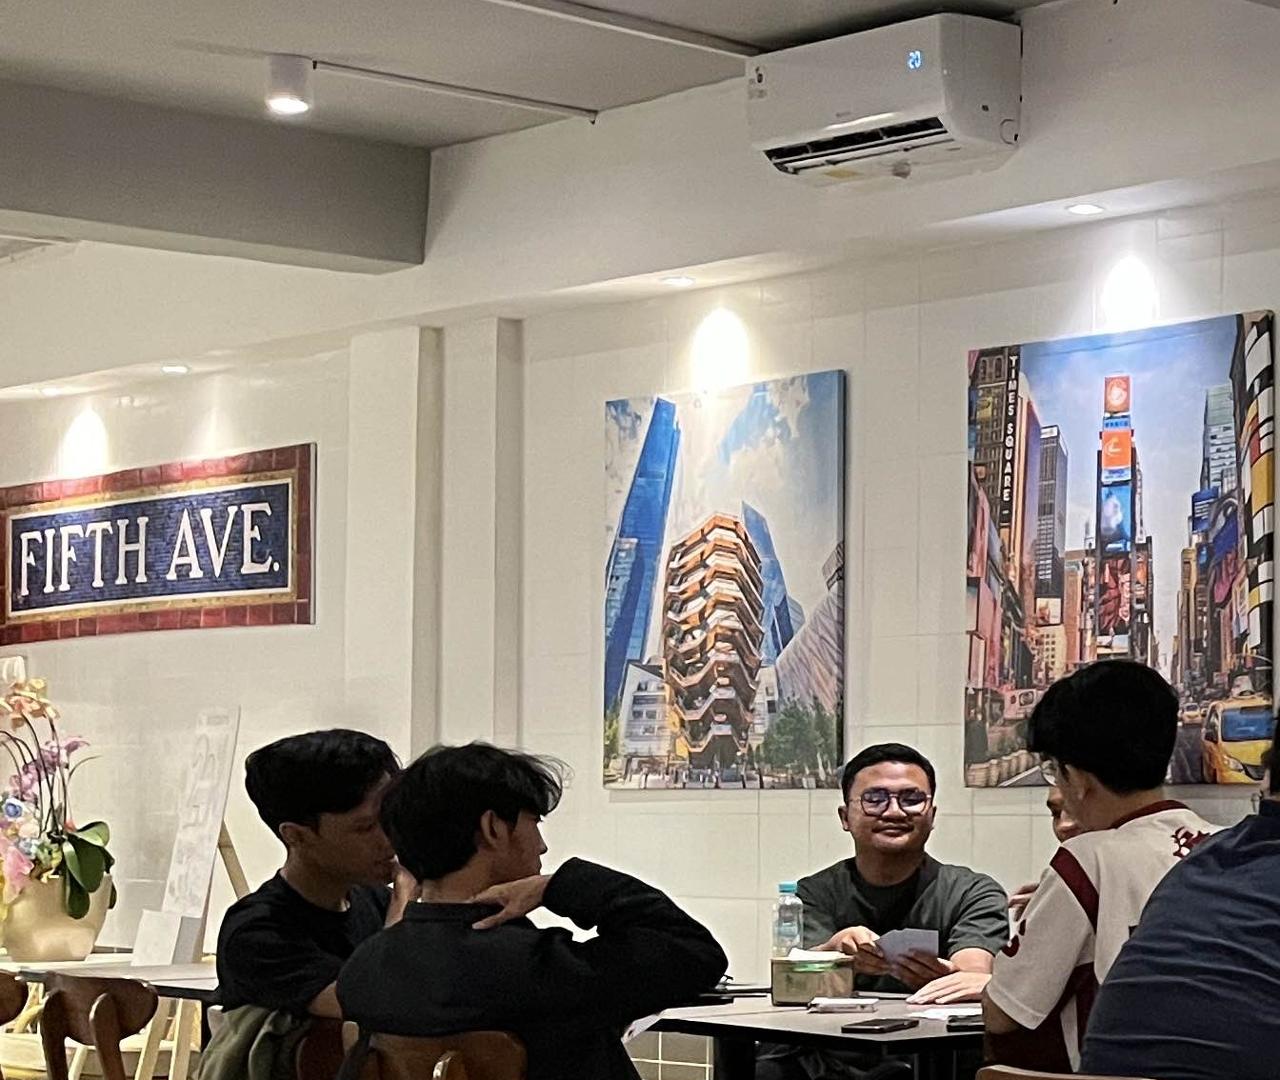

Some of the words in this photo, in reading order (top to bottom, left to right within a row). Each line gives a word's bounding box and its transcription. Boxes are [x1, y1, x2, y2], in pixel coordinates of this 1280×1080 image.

[1008, 355, 1018, 416] TIMES
[1003, 423, 1014, 501] SQUARE
[20, 516, 149, 596] FIFTH
[166, 502, 280, 581] AVE.
